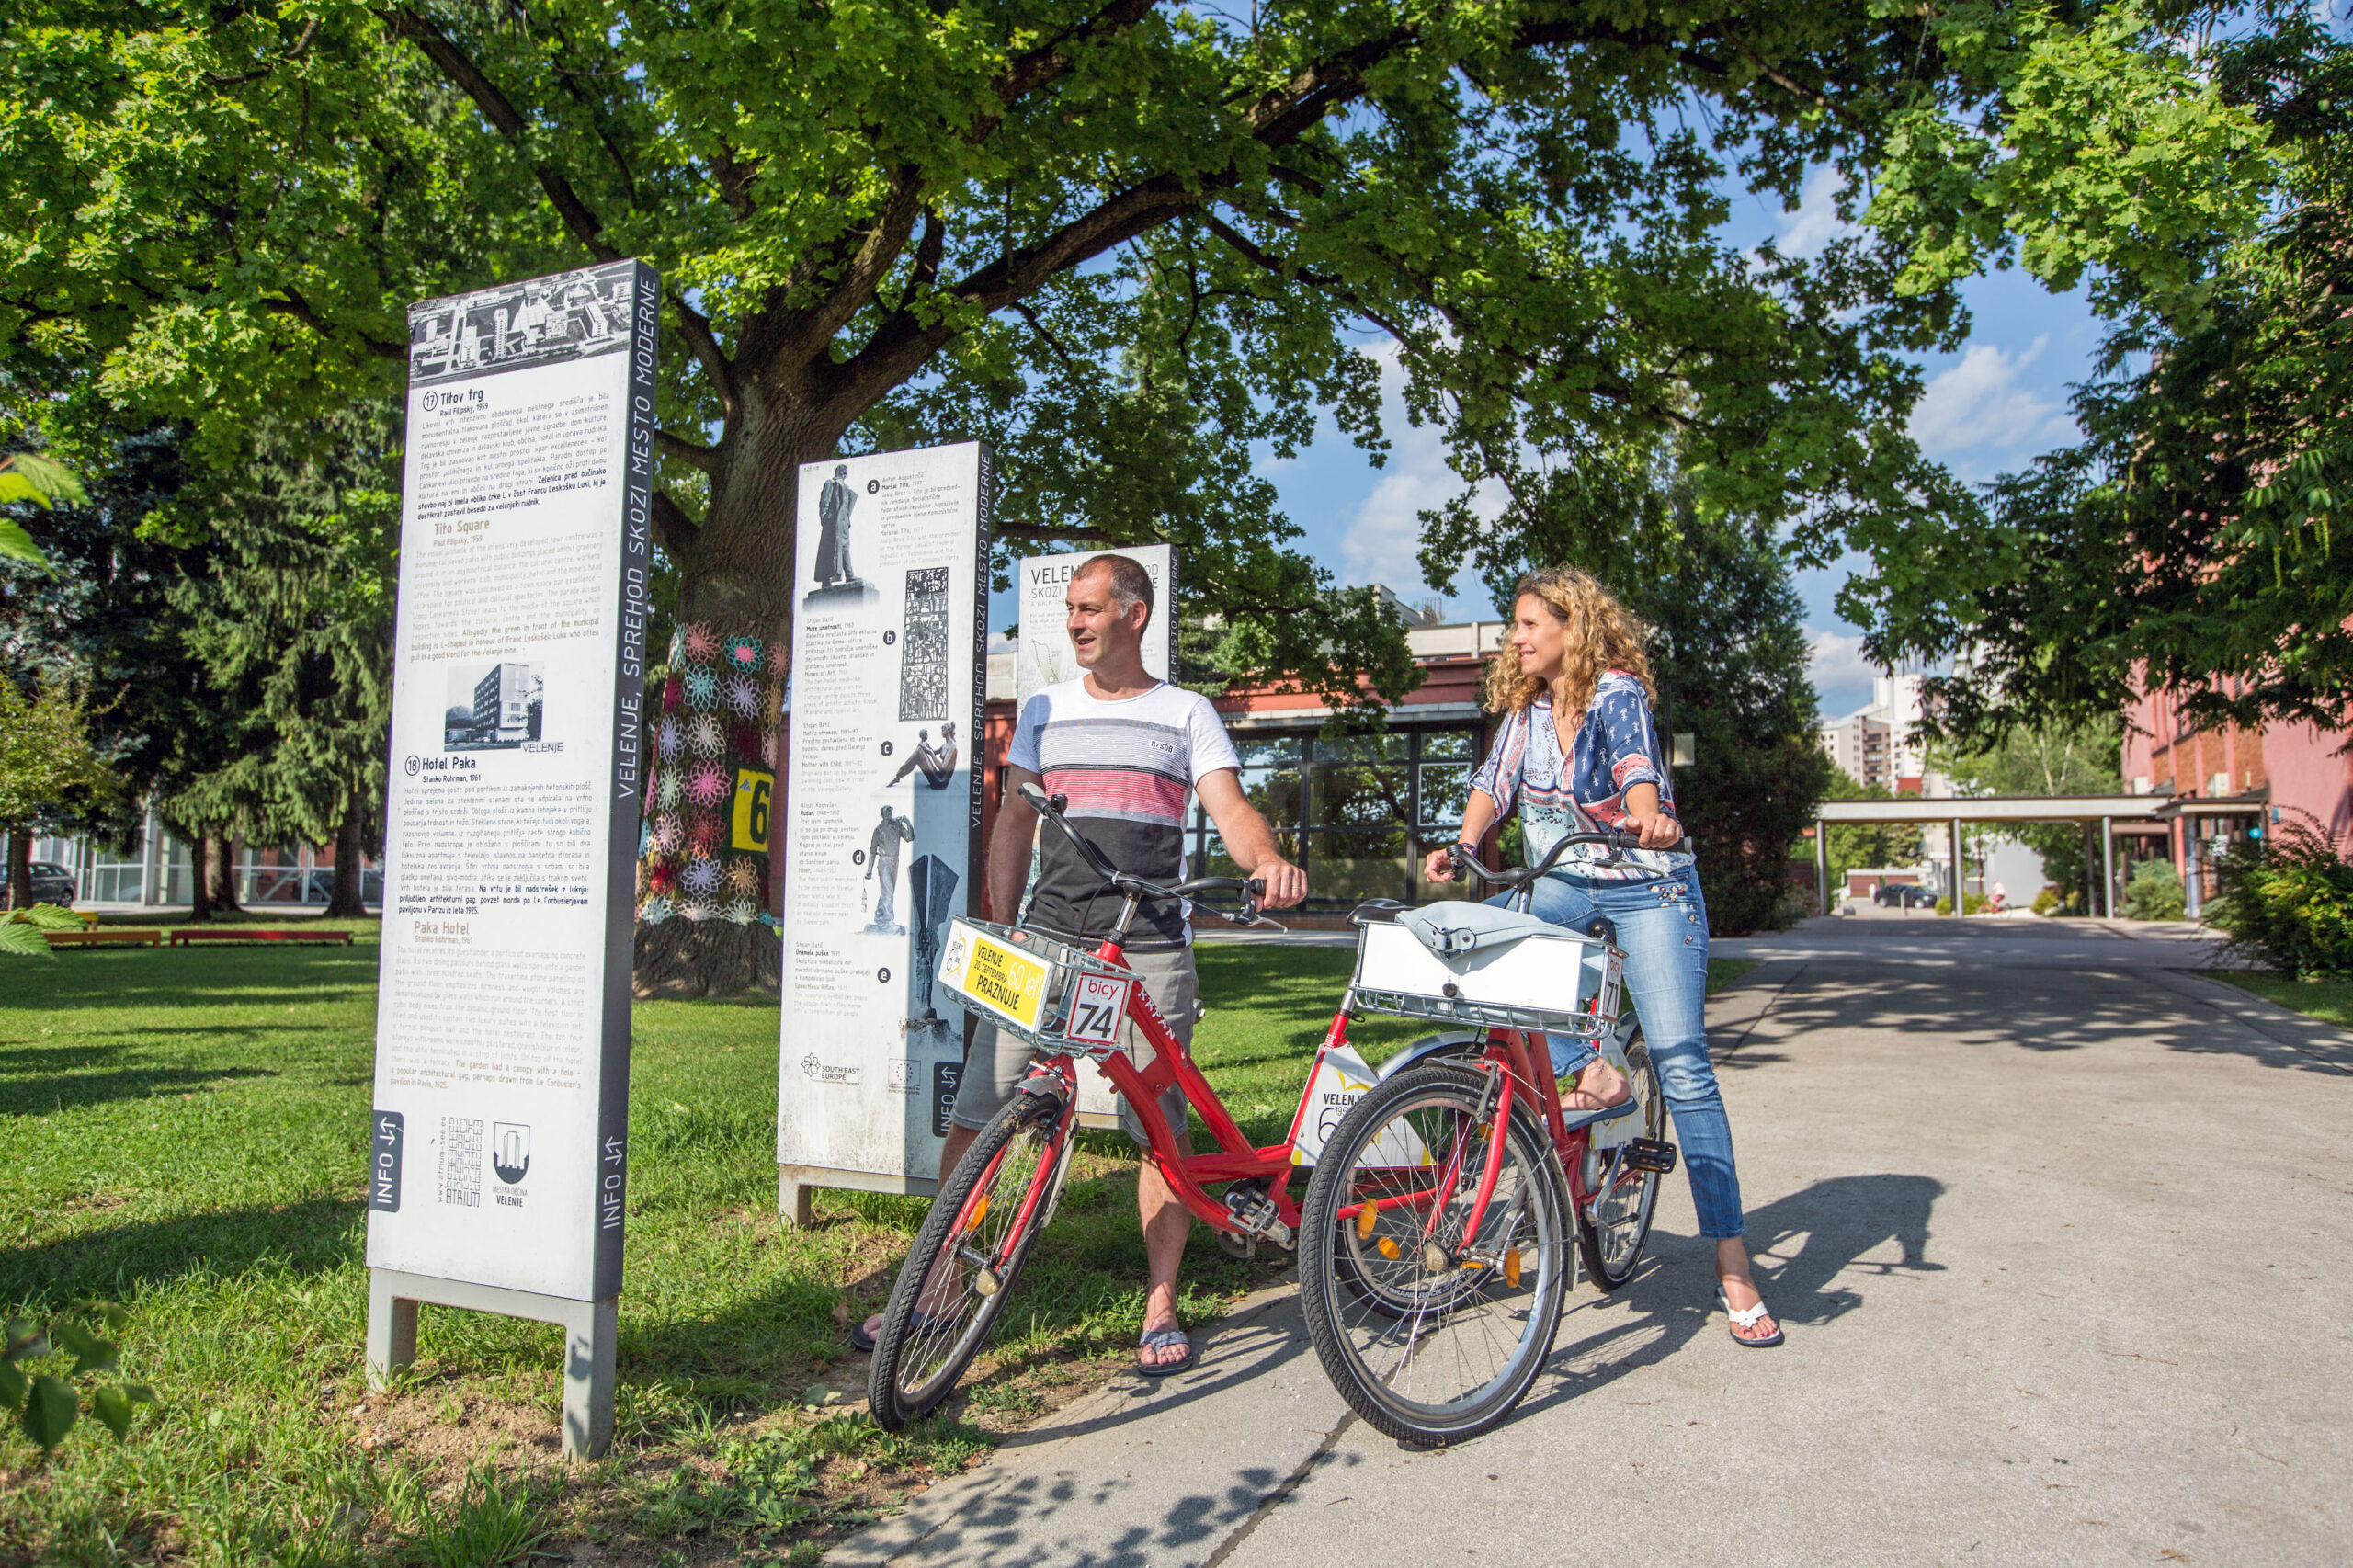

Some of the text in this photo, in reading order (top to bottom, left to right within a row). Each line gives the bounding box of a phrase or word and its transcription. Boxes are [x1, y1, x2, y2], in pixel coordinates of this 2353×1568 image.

[426, 389, 483, 407] 17 Titov trg
[439, 402, 488, 416] Paul Filipsky, 1959
[538, 467, 606, 483] Zelenica pred občinsko
[418, 501, 437, 509] stavbo
[438, 499, 446, 507] naj
[454, 496, 468, 505] imela
[470, 494, 486, 503] obliko
[513, 489, 525, 497] čast
[548, 481, 575, 493] Leskošku
[577, 480, 590, 488] Luki,
[599, 477, 605, 486] je
[417, 510, 442, 519] dostikrat
[443, 506, 465, 517] zastavil
[466, 505, 486, 514] besedo
[495, 500, 519, 510] velenjski
[521, 497, 540, 506] rudnik.
[434, 519, 489, 535] Tito Square
[618, 276, 656, 799] VELENJE, SPREHOD SKOZI MESTO MODERNE
[1031, 586, 1061, 599] SKOZI
[886, 631, 892, 642] b
[972, 453, 991, 827] VELENJE, SPREHOD SKOZI MESTO MODERNE
[1170, 621, 1178, 665] MESTO
[522, 742, 563, 752] VELENJE
[407, 756, 475, 771] 18 Hotel Paka
[856, 851, 861, 862] d
[505, 885, 511, 893] je
[525, 884, 558, 892] nadstrešek
[569, 885, 588, 894] luknjo:
[399, 894, 426, 903] priljubljeni
[480, 895, 499, 904] povzet
[398, 905, 422, 915] paviljonu
[465, 904, 478, 914] 1925.
[414, 920, 469, 935] Paka Hotel
[978, 944, 1004, 968] VELENJE
[881, 971, 887, 980] e
[973, 960, 982, 971] 20.
[981, 962, 1007, 984] SEPTEMBRA
[1007, 961, 1043, 999] 60 let!
[976, 974, 1020, 1011] PRAZNUJE
[1088, 980, 1120, 1000] bicy
[1605, 981, 1618, 1015] 71
[1075, 1003, 1114, 1039] 74
[1138, 988, 1176, 1040] KRPAN
[822, 1073, 845, 1081] EUROPE
[377, 1153, 394, 1204] INFO
[446, 1188, 480, 1207] ATRIUM
[496, 1195, 522, 1207] VELENJE
[603, 1173, 622, 1230] INFO
